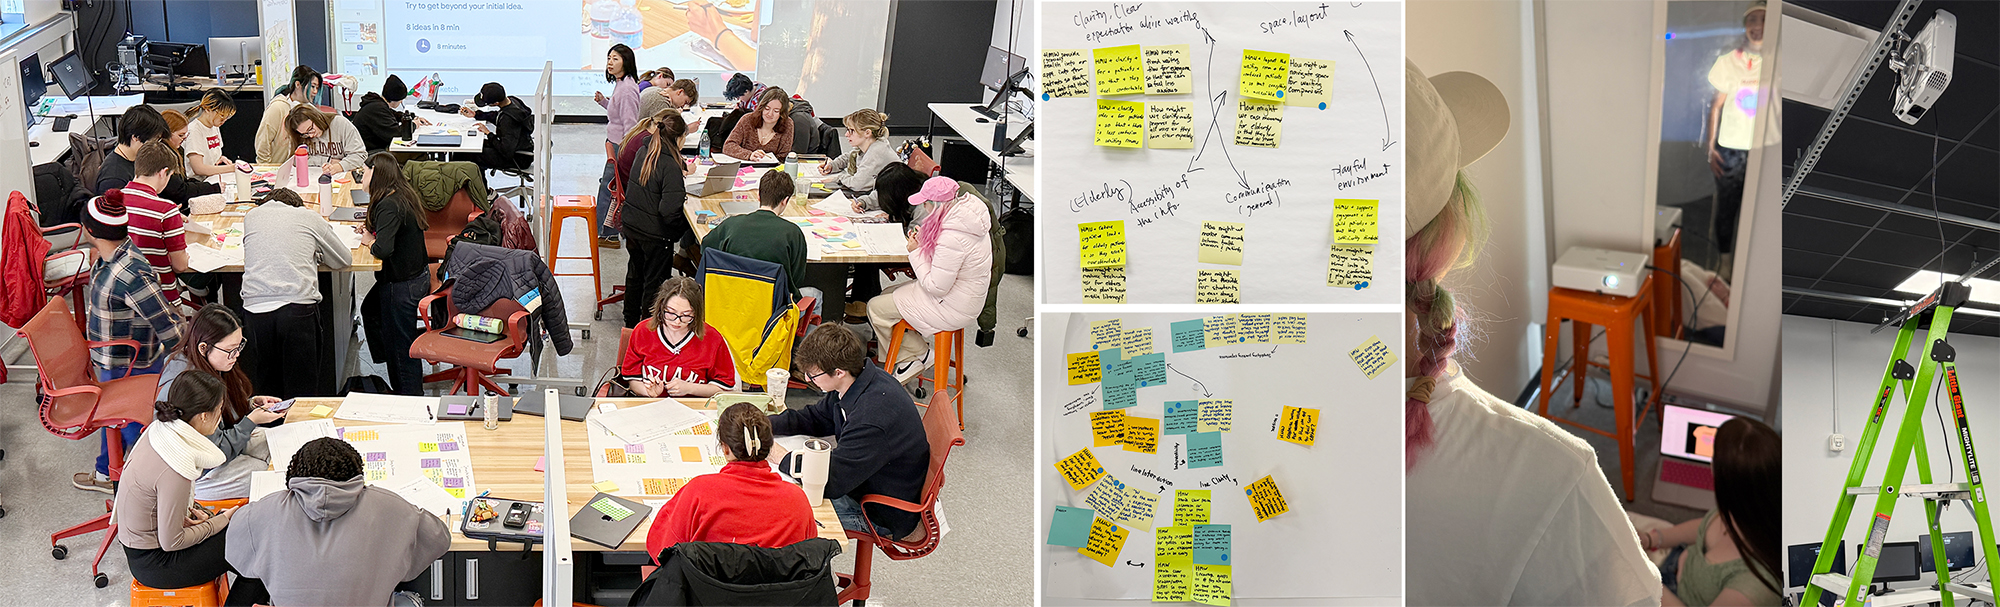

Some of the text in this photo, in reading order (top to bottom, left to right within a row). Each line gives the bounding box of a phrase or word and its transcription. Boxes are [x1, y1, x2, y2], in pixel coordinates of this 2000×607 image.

[405, 2, 417, 11] Try
[427, 3, 439, 11] get
[440, 2, 467, 11] beyond
[468, 3, 485, 11] your
[506, 2, 524, 10] idea.
[1946, 370, 1976, 470] Little Giant MIGHTYLITE
